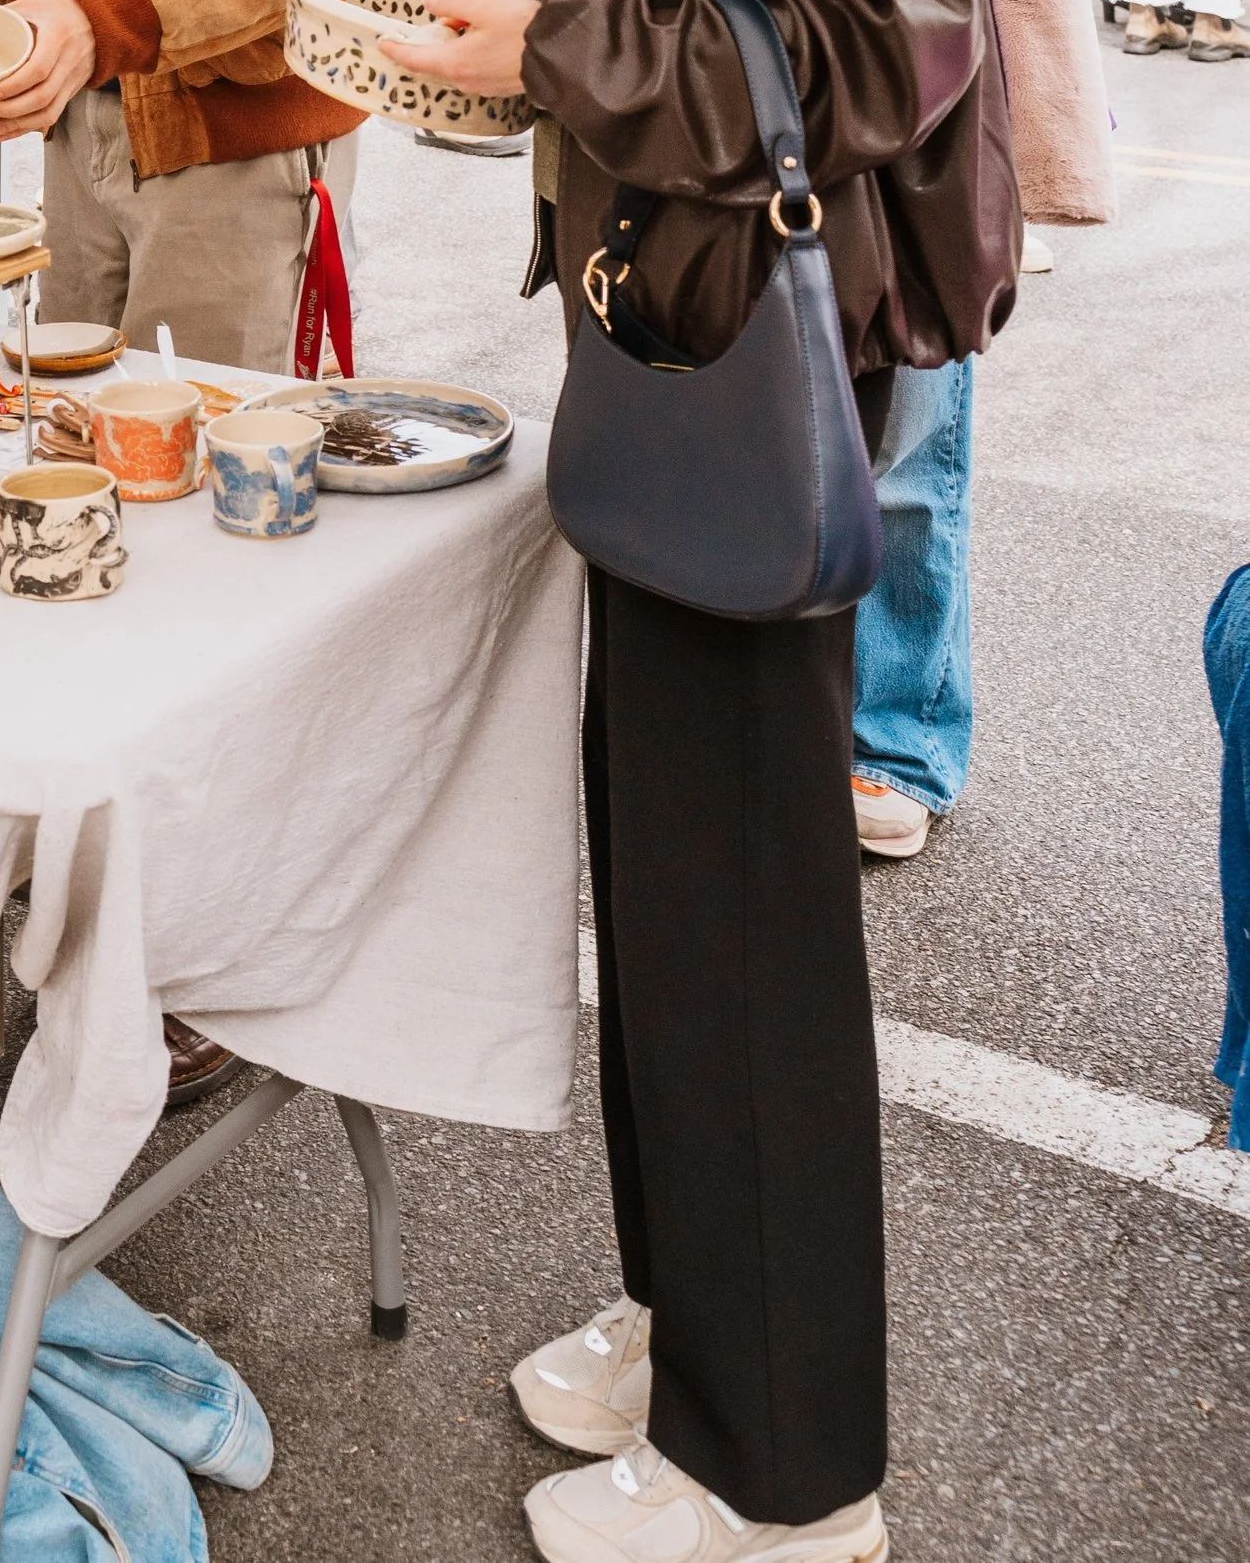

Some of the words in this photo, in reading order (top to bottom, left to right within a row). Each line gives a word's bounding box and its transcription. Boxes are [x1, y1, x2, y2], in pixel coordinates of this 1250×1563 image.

[307, 289, 318, 314] #Run
[305, 316, 316, 329] for
[302, 332, 315, 357] Ryan
